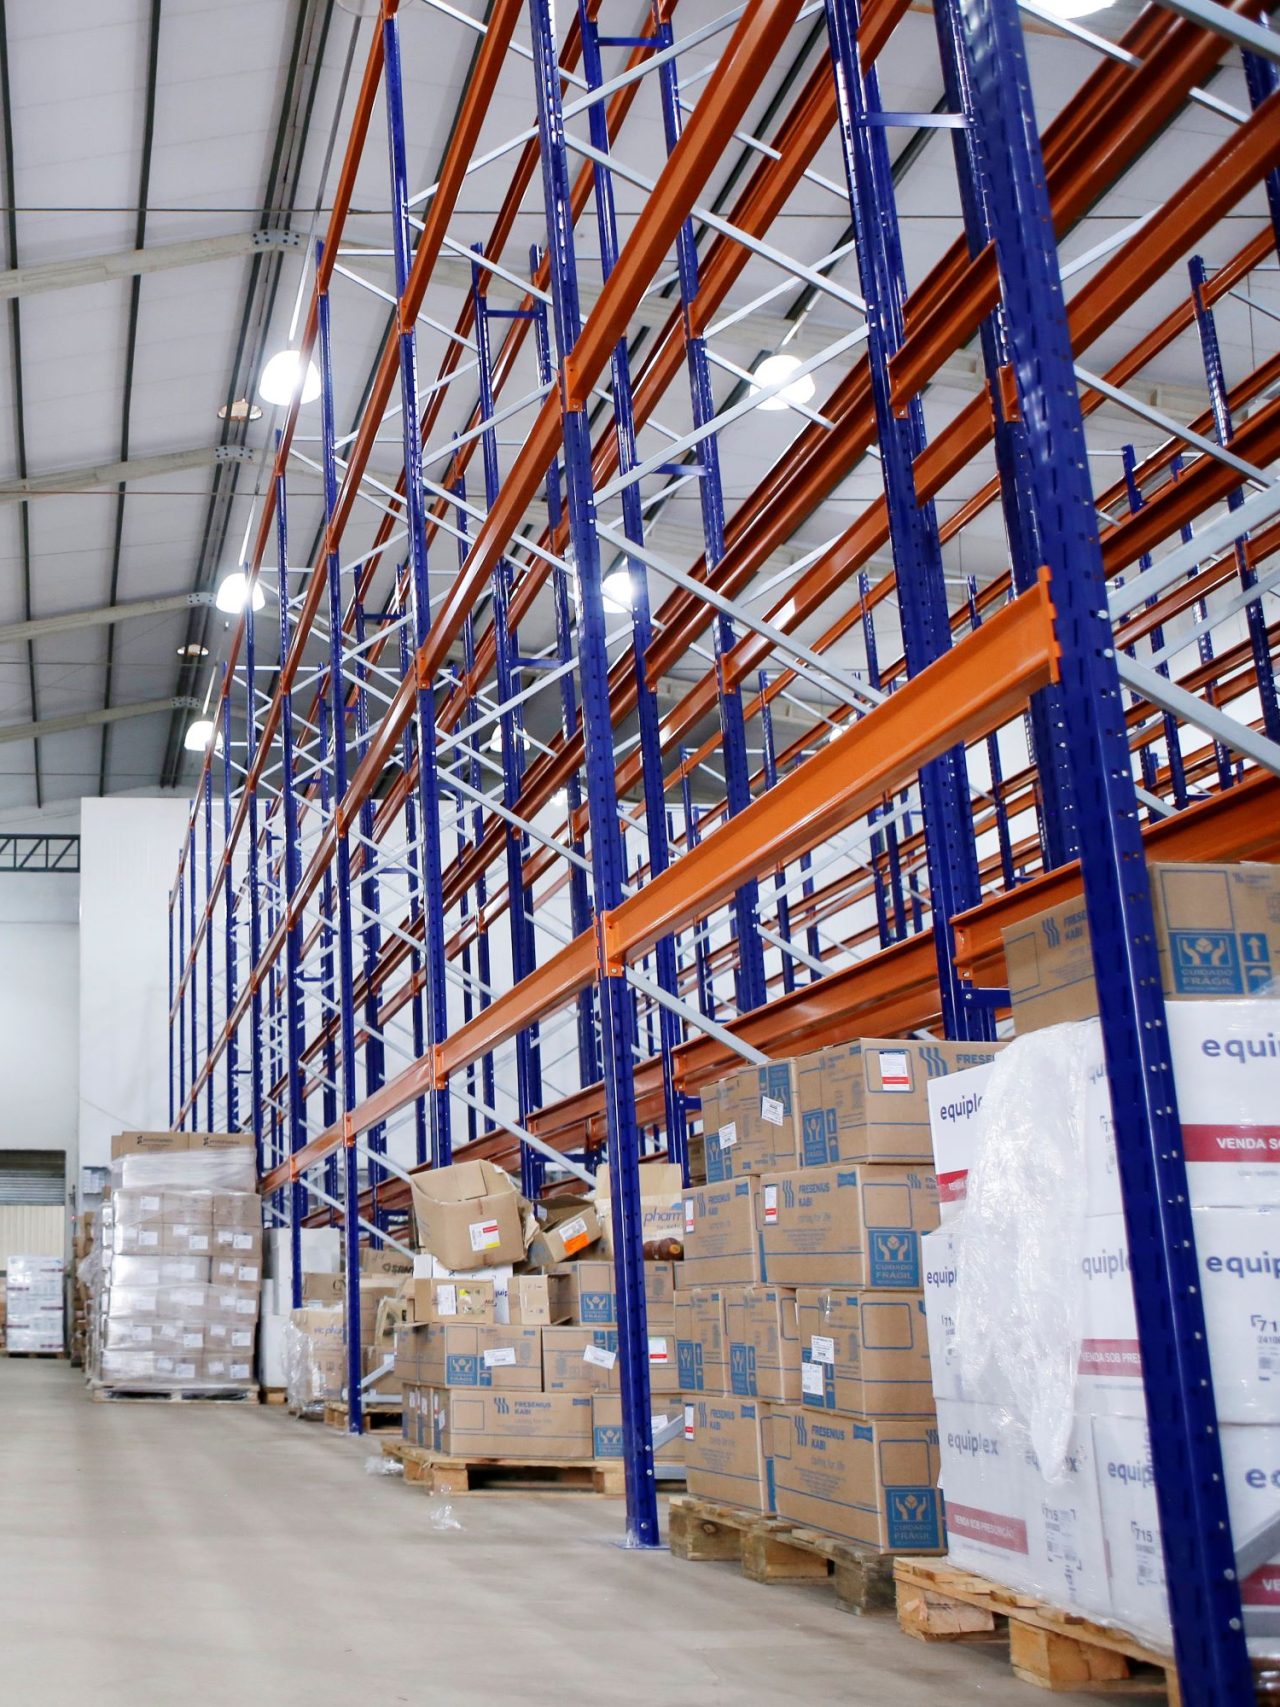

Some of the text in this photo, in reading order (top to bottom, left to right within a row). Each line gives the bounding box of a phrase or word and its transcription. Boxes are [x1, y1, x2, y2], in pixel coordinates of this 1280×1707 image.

[1181, 968, 1234, 978] CUIDADO
[1181, 976, 1234, 987] FRÁGIL
[1202, 1032, 1280, 1064] equi
[956, 1054, 995, 1065] FRESE
[940, 1093, 983, 1123] equipl
[1216, 1138, 1267, 1150] VENDA
[644, 1206, 681, 1228] pharm
[1082, 1248, 1131, 1280] quipl
[926, 1266, 958, 1288] equipl
[1257, 1319, 1277, 1333] 71
[811, 1424, 846, 1441] FRESENIUS
[948, 1432, 999, 1456] equiplex
[1108, 1459, 1154, 1488] equip
[1135, 1526, 1154, 1544] 715
